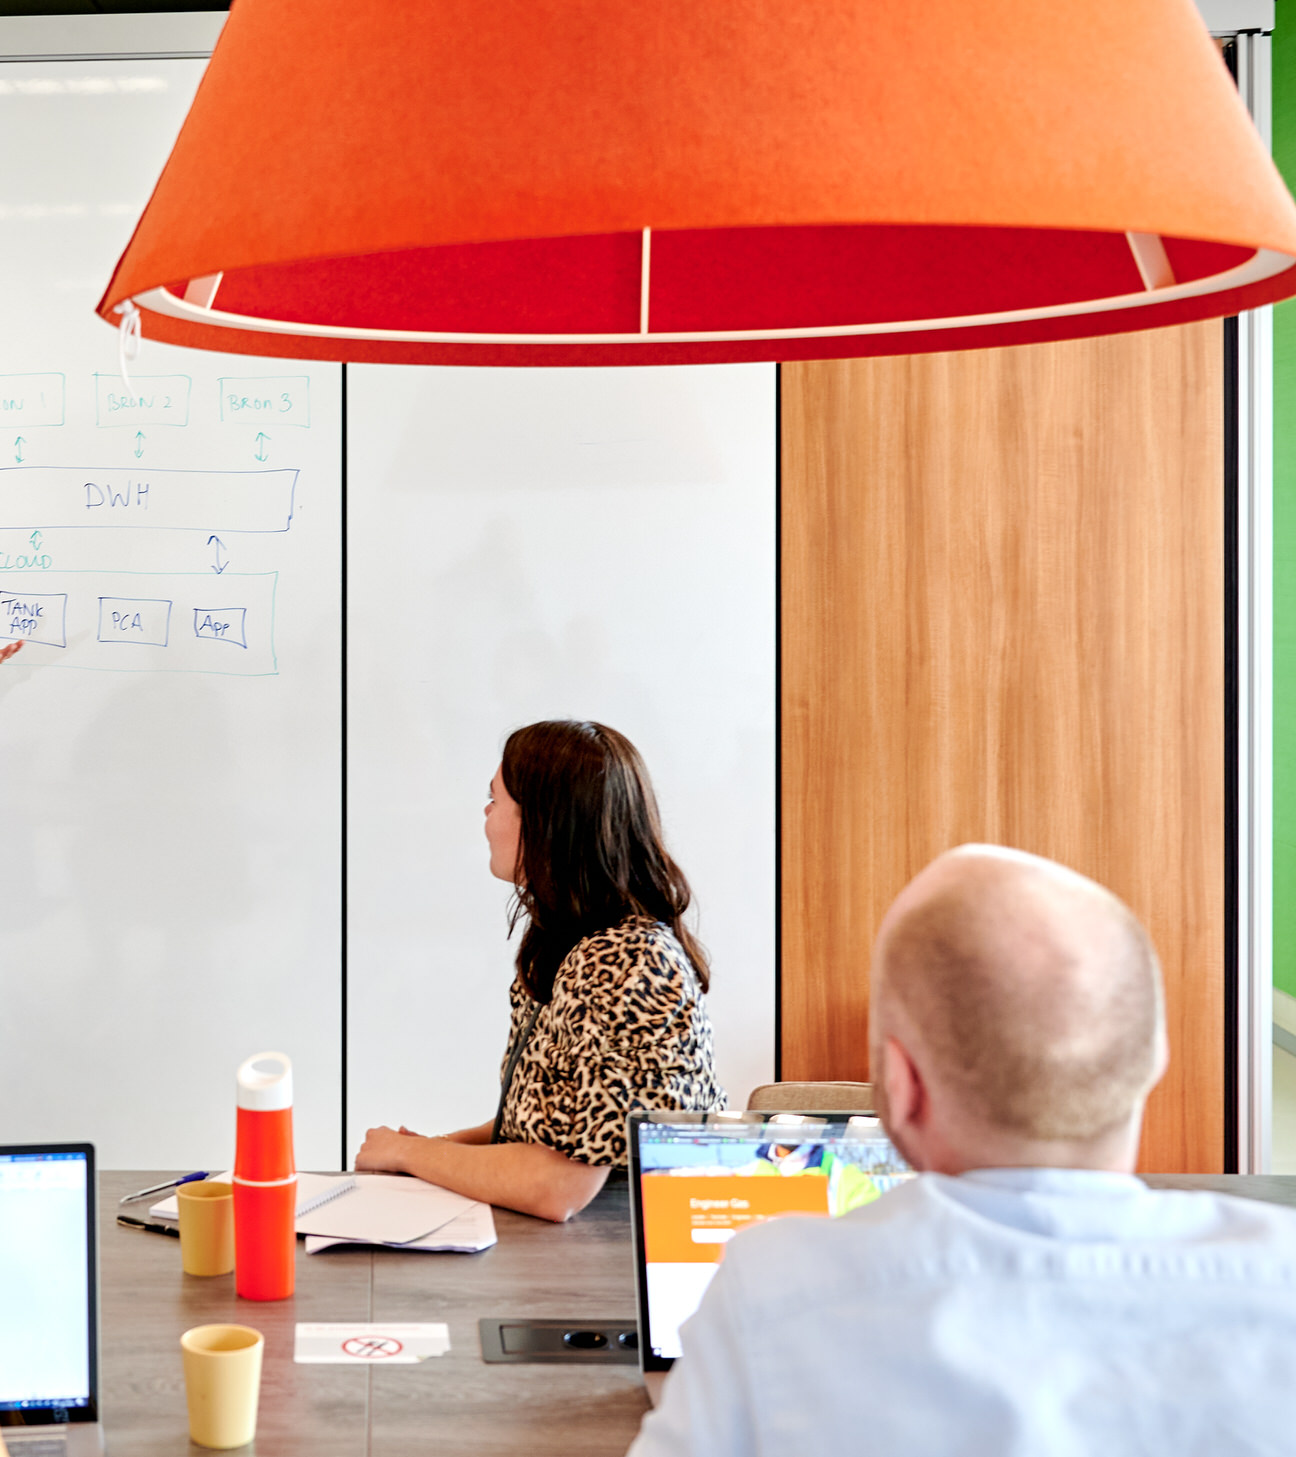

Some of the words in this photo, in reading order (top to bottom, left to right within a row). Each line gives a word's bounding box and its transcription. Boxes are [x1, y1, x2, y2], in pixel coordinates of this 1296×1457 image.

[163, 396, 173, 409] 2
[278, 392, 293, 413] 3
[83, 480, 150, 510] DWH
[1, 598, 44, 618] TANK
[111, 611, 144, 632] PCA
